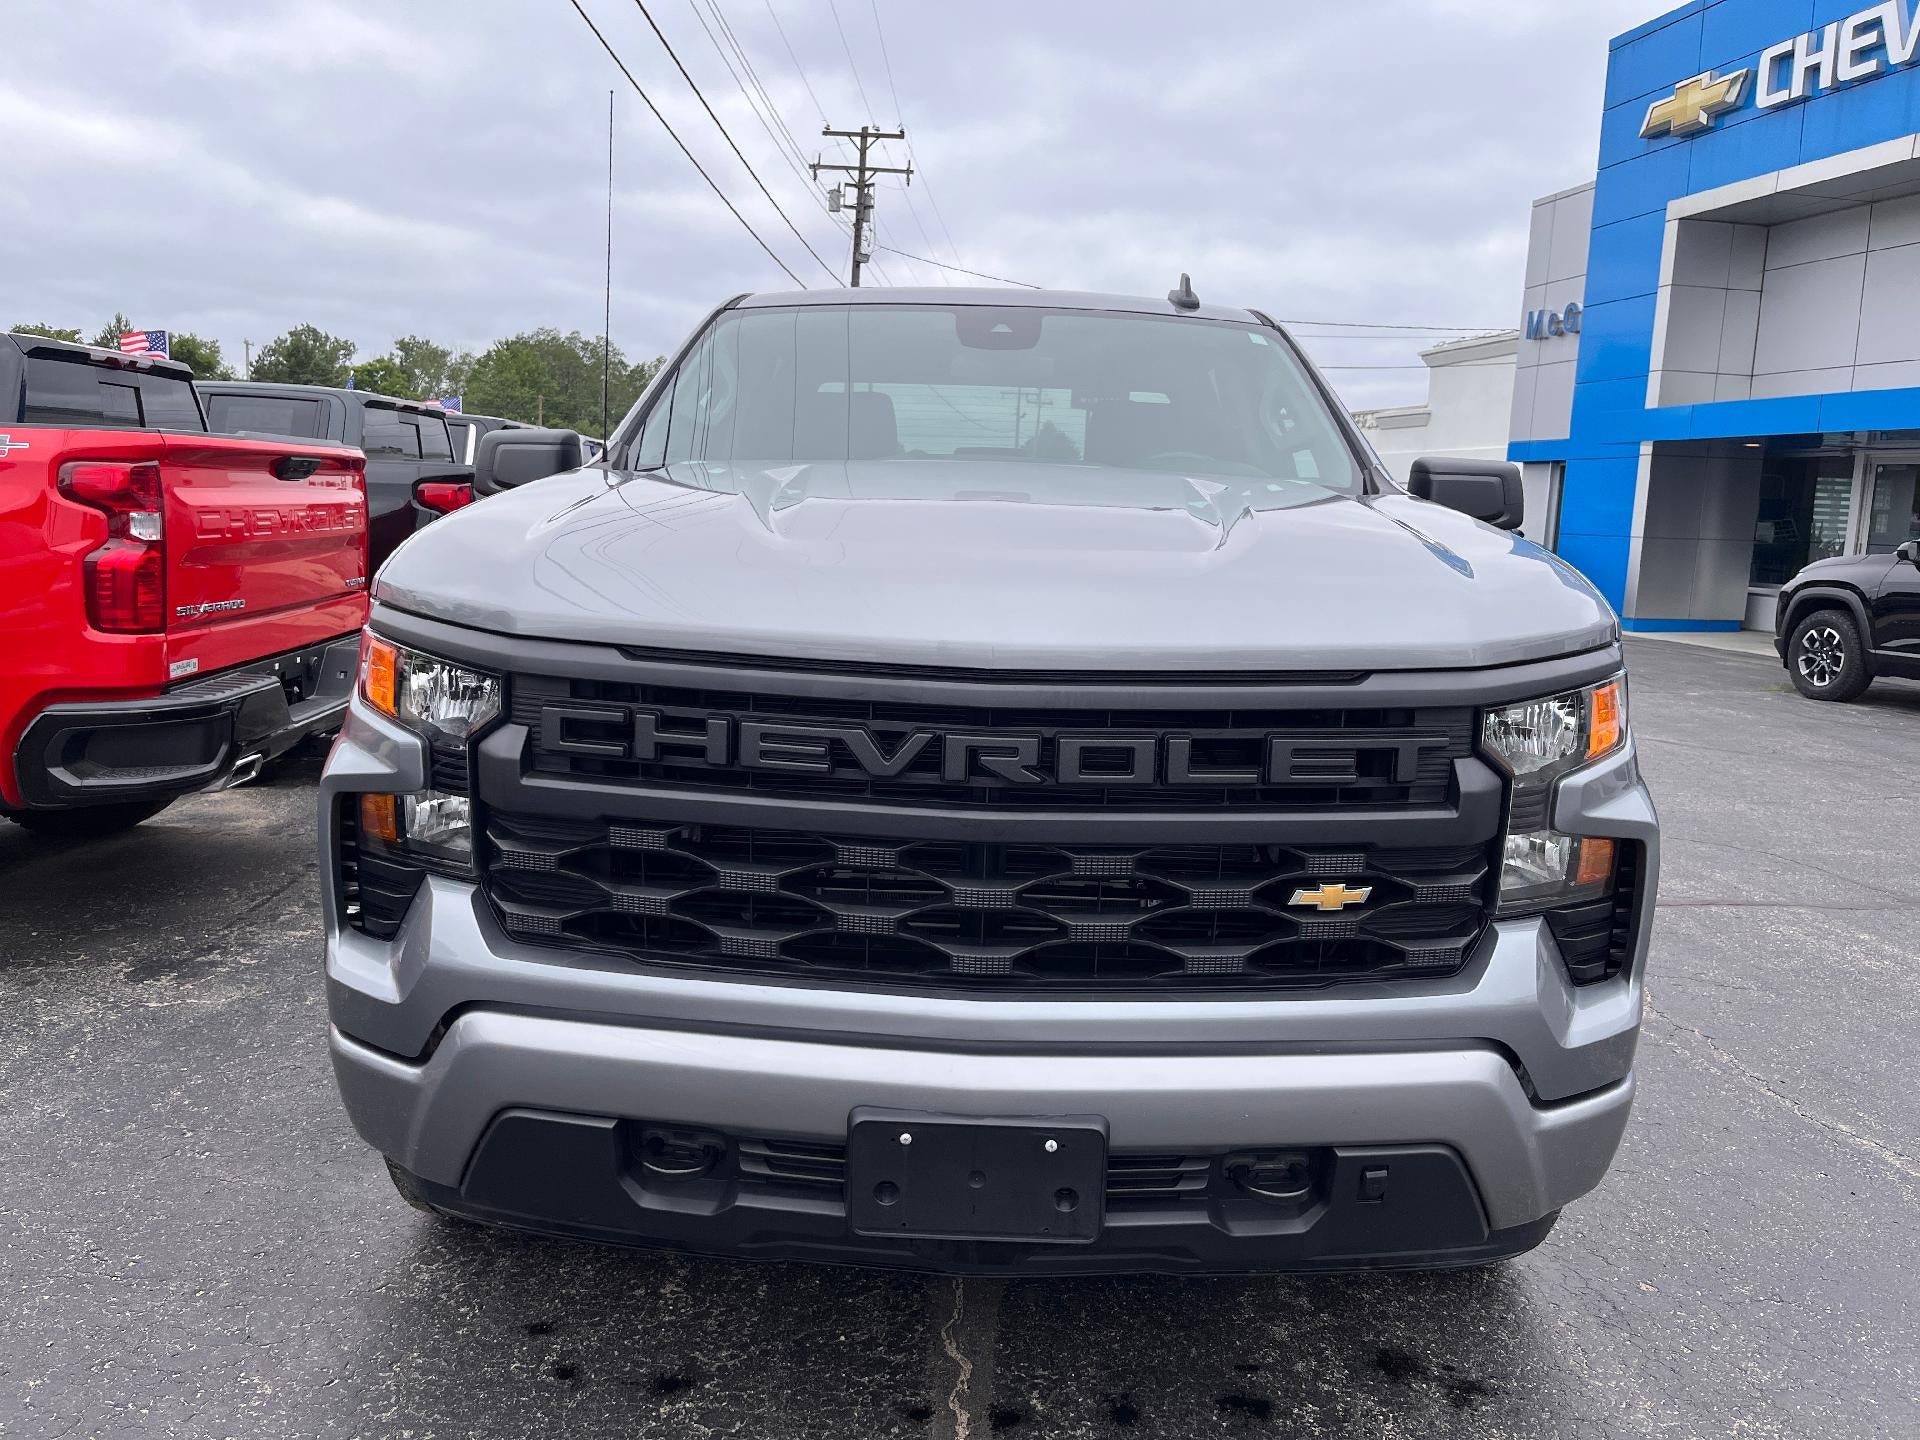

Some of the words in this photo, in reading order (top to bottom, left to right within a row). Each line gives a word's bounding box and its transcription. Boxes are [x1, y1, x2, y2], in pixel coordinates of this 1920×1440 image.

[1756, 0, 1920, 109] CHEV
[196, 504, 365, 539] CHEVROLET
[176, 599, 246, 616] SILVERADO
[541, 703, 1450, 785] CHEVROLET
